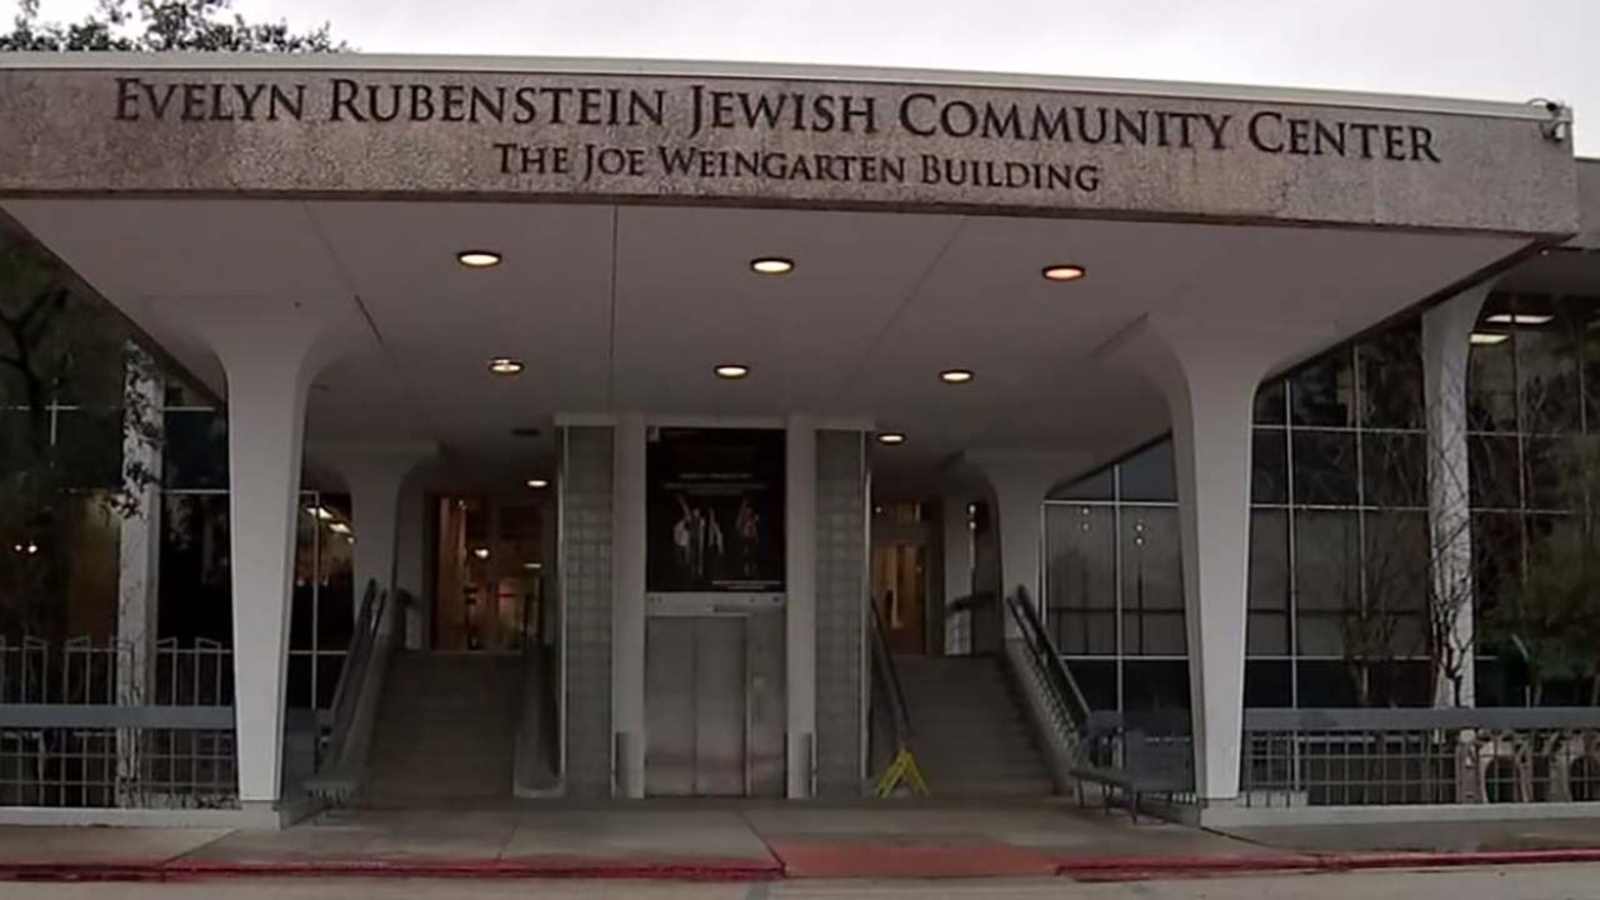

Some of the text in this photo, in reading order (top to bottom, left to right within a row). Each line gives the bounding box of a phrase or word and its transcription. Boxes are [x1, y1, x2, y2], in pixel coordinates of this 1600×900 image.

[115, 77, 1441, 163] EVELYN RUBENSTEIN JEWISH COMMUNITY CENTER
[494, 143, 1100, 193] THE JOE WEINGARTEN BUILDING
